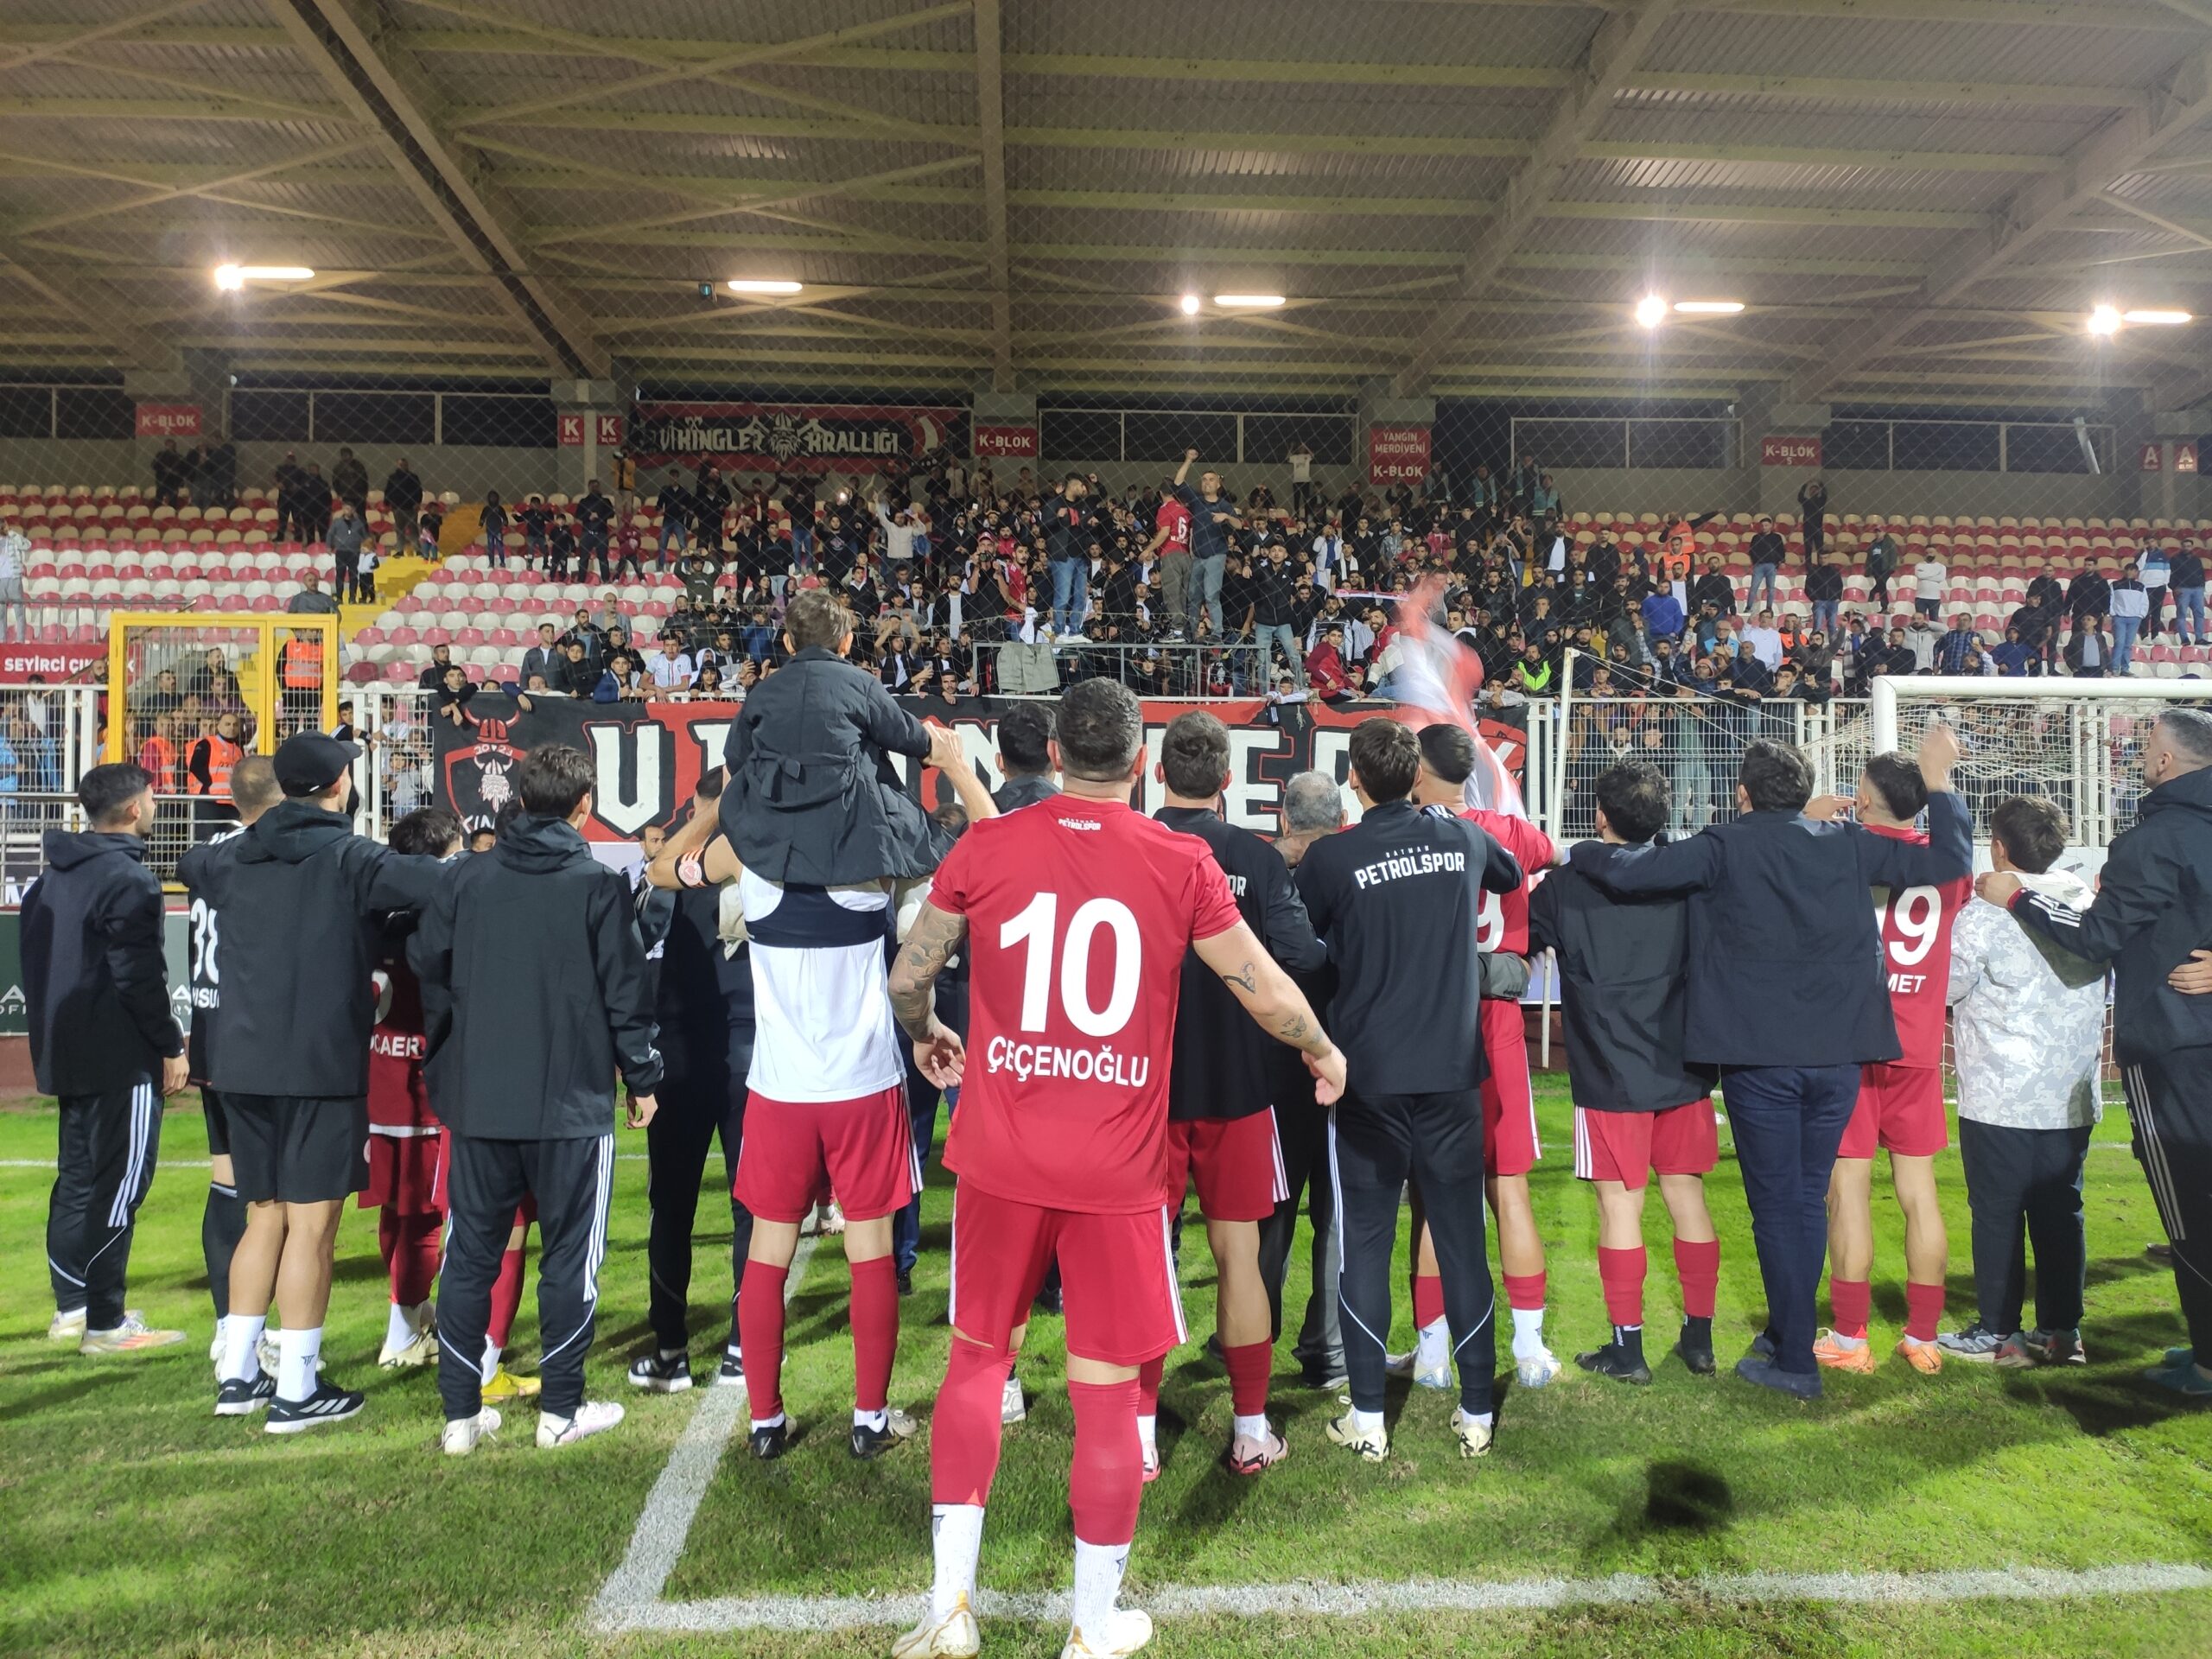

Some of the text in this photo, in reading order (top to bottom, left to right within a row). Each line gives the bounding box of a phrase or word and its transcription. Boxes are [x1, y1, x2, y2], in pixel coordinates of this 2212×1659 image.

[142, 415, 196, 427] K-BLOK
[564, 417, 580, 436] K
[601, 416, 616, 436] K
[979, 434, 1031, 448] K-BLOK
[1383, 432, 1418, 442] YANGIN
[1375, 442, 1426, 454] MERDİVENİ
[1765, 444, 1815, 457] K-BLOK
[2145, 446, 2158, 463] A
[2178, 446, 2193, 463] A
[1373, 464, 1423, 477] K-BLOK
[3, 655, 66, 672] SEYİRCİ
[1385, 845, 1430, 858] BATMAN
[1354, 852, 1465, 890] PETROLSPOR
[1000, 891, 1142, 1038] 10
[987, 1035, 1150, 1088] ÇEÇENOĞLU
